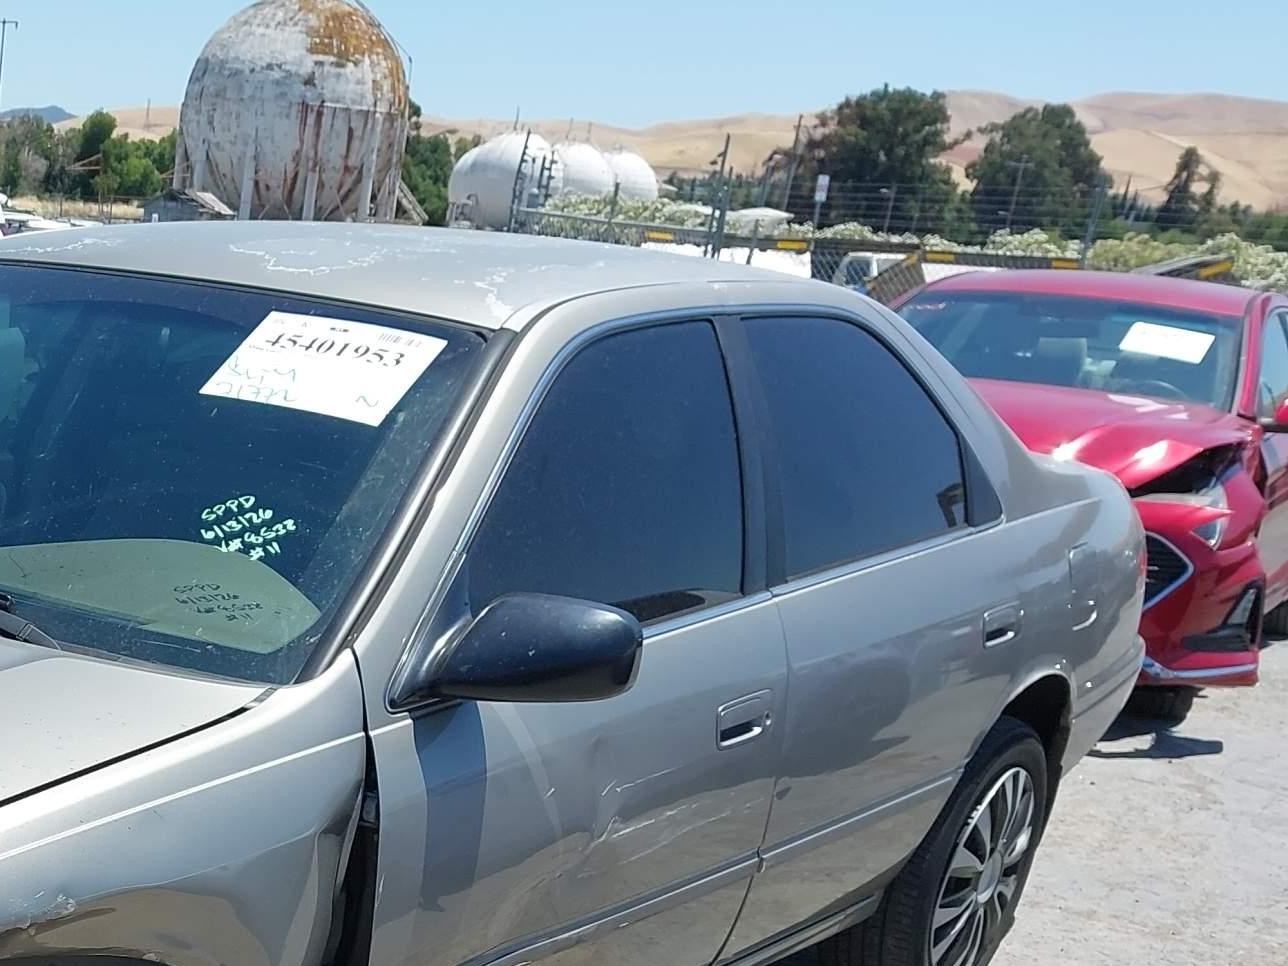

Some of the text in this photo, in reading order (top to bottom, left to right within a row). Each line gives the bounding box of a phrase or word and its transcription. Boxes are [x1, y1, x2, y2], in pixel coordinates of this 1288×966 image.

[265, 333, 405, 367] 45401953
[200, 508, 273, 539] 6/13/26
[201, 495, 256, 521] SPPD
